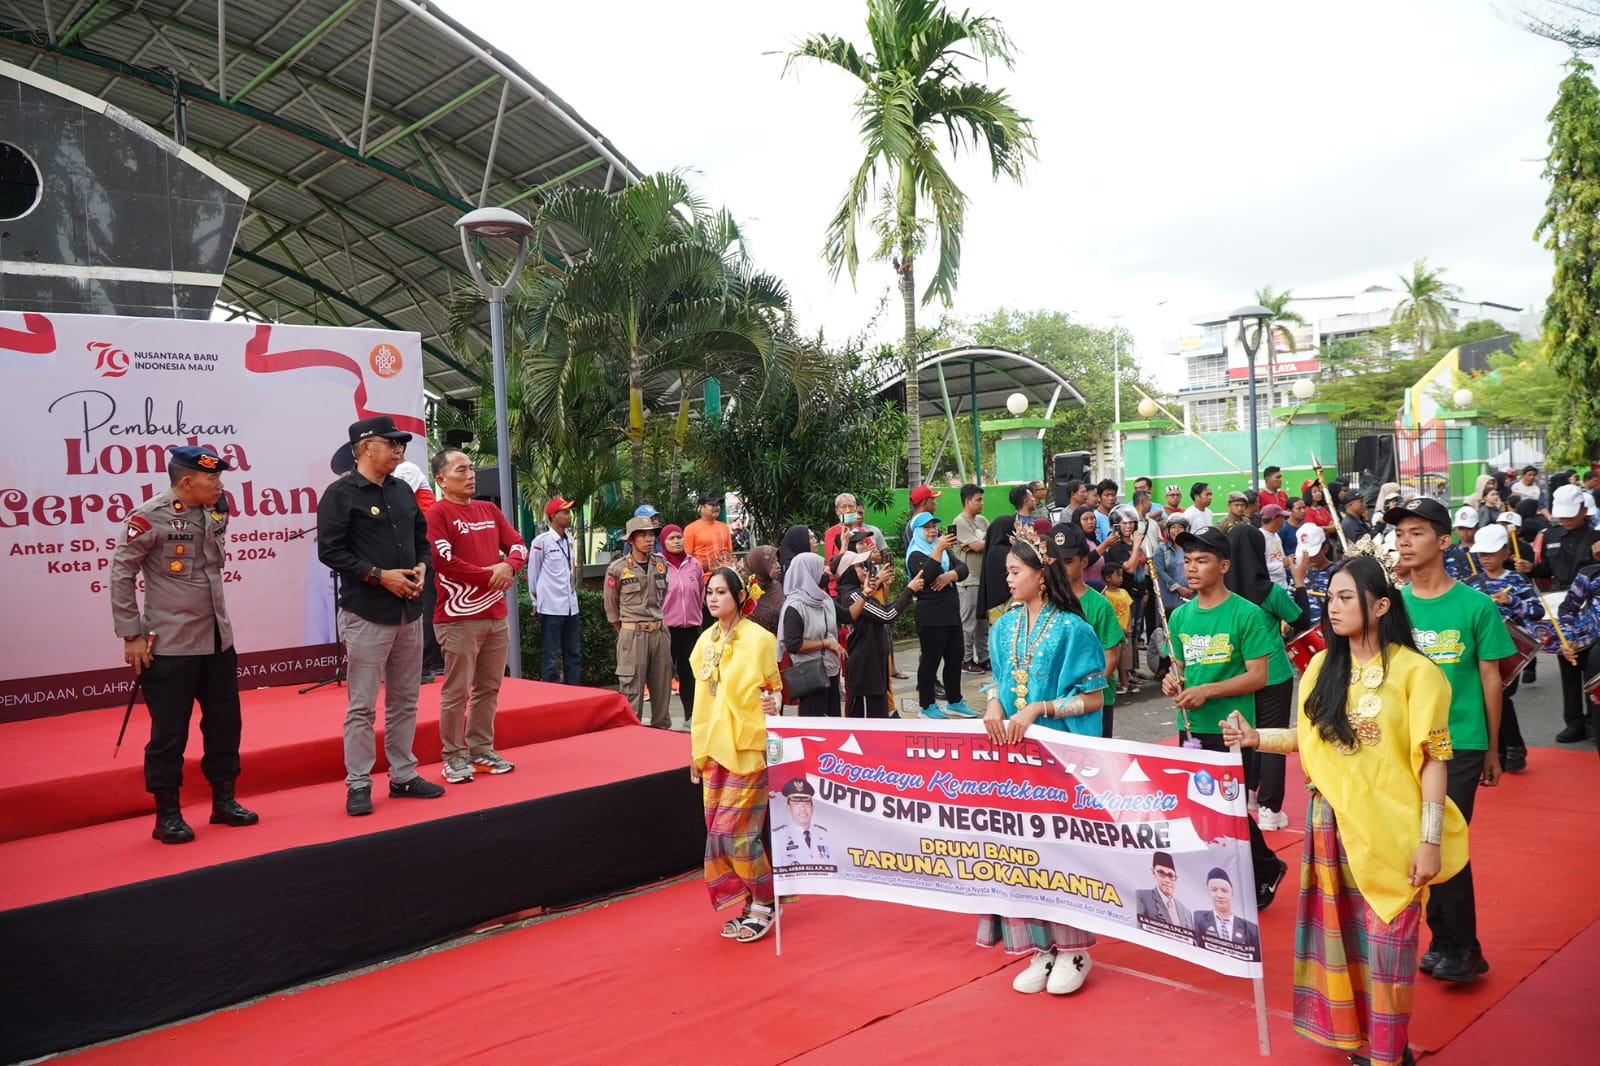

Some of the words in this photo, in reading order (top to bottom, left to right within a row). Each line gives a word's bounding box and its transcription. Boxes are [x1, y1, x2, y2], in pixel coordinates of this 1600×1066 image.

[134, 352, 191, 361] NUSANTARA
[193, 353, 219, 362] BARU
[134, 362, 186, 371] INDONESIA
[188, 363, 215, 372] MAJU
[48, 389, 238, 454] Pembukaan
[9, 542, 65, 557] Antar
[70, 539, 100, 553] SD,
[231, 528, 304, 543] sederajat
[47, 560, 92, 574] Kota
[237, 547, 276, 561] 2024
[223, 570, 243, 583] 24
[270, 659, 303, 674] KOTA
[905, 735, 965, 760] HUT
[1007, 740, 1043, 767] KE
[1062, 749, 1102, 778] 79
[818, 752, 925, 792] Dirgahayu
[927, 770, 1069, 803] Kemerdekaan
[1072, 783, 1178, 813] Indonesia
[818, 778, 877, 814] UPTD
[882, 795, 932, 824] SMP
[938, 804, 1025, 837] NEGERI
[1029, 814, 1045, 838] 9
[1052, 815, 1171, 849] PAREPARE
[919, 837, 980, 859] DRUM
[983, 841, 1040, 867] BAND
[847, 847, 954, 879] TARUNA
[957, 858, 1124, 908] LOKANANTA
